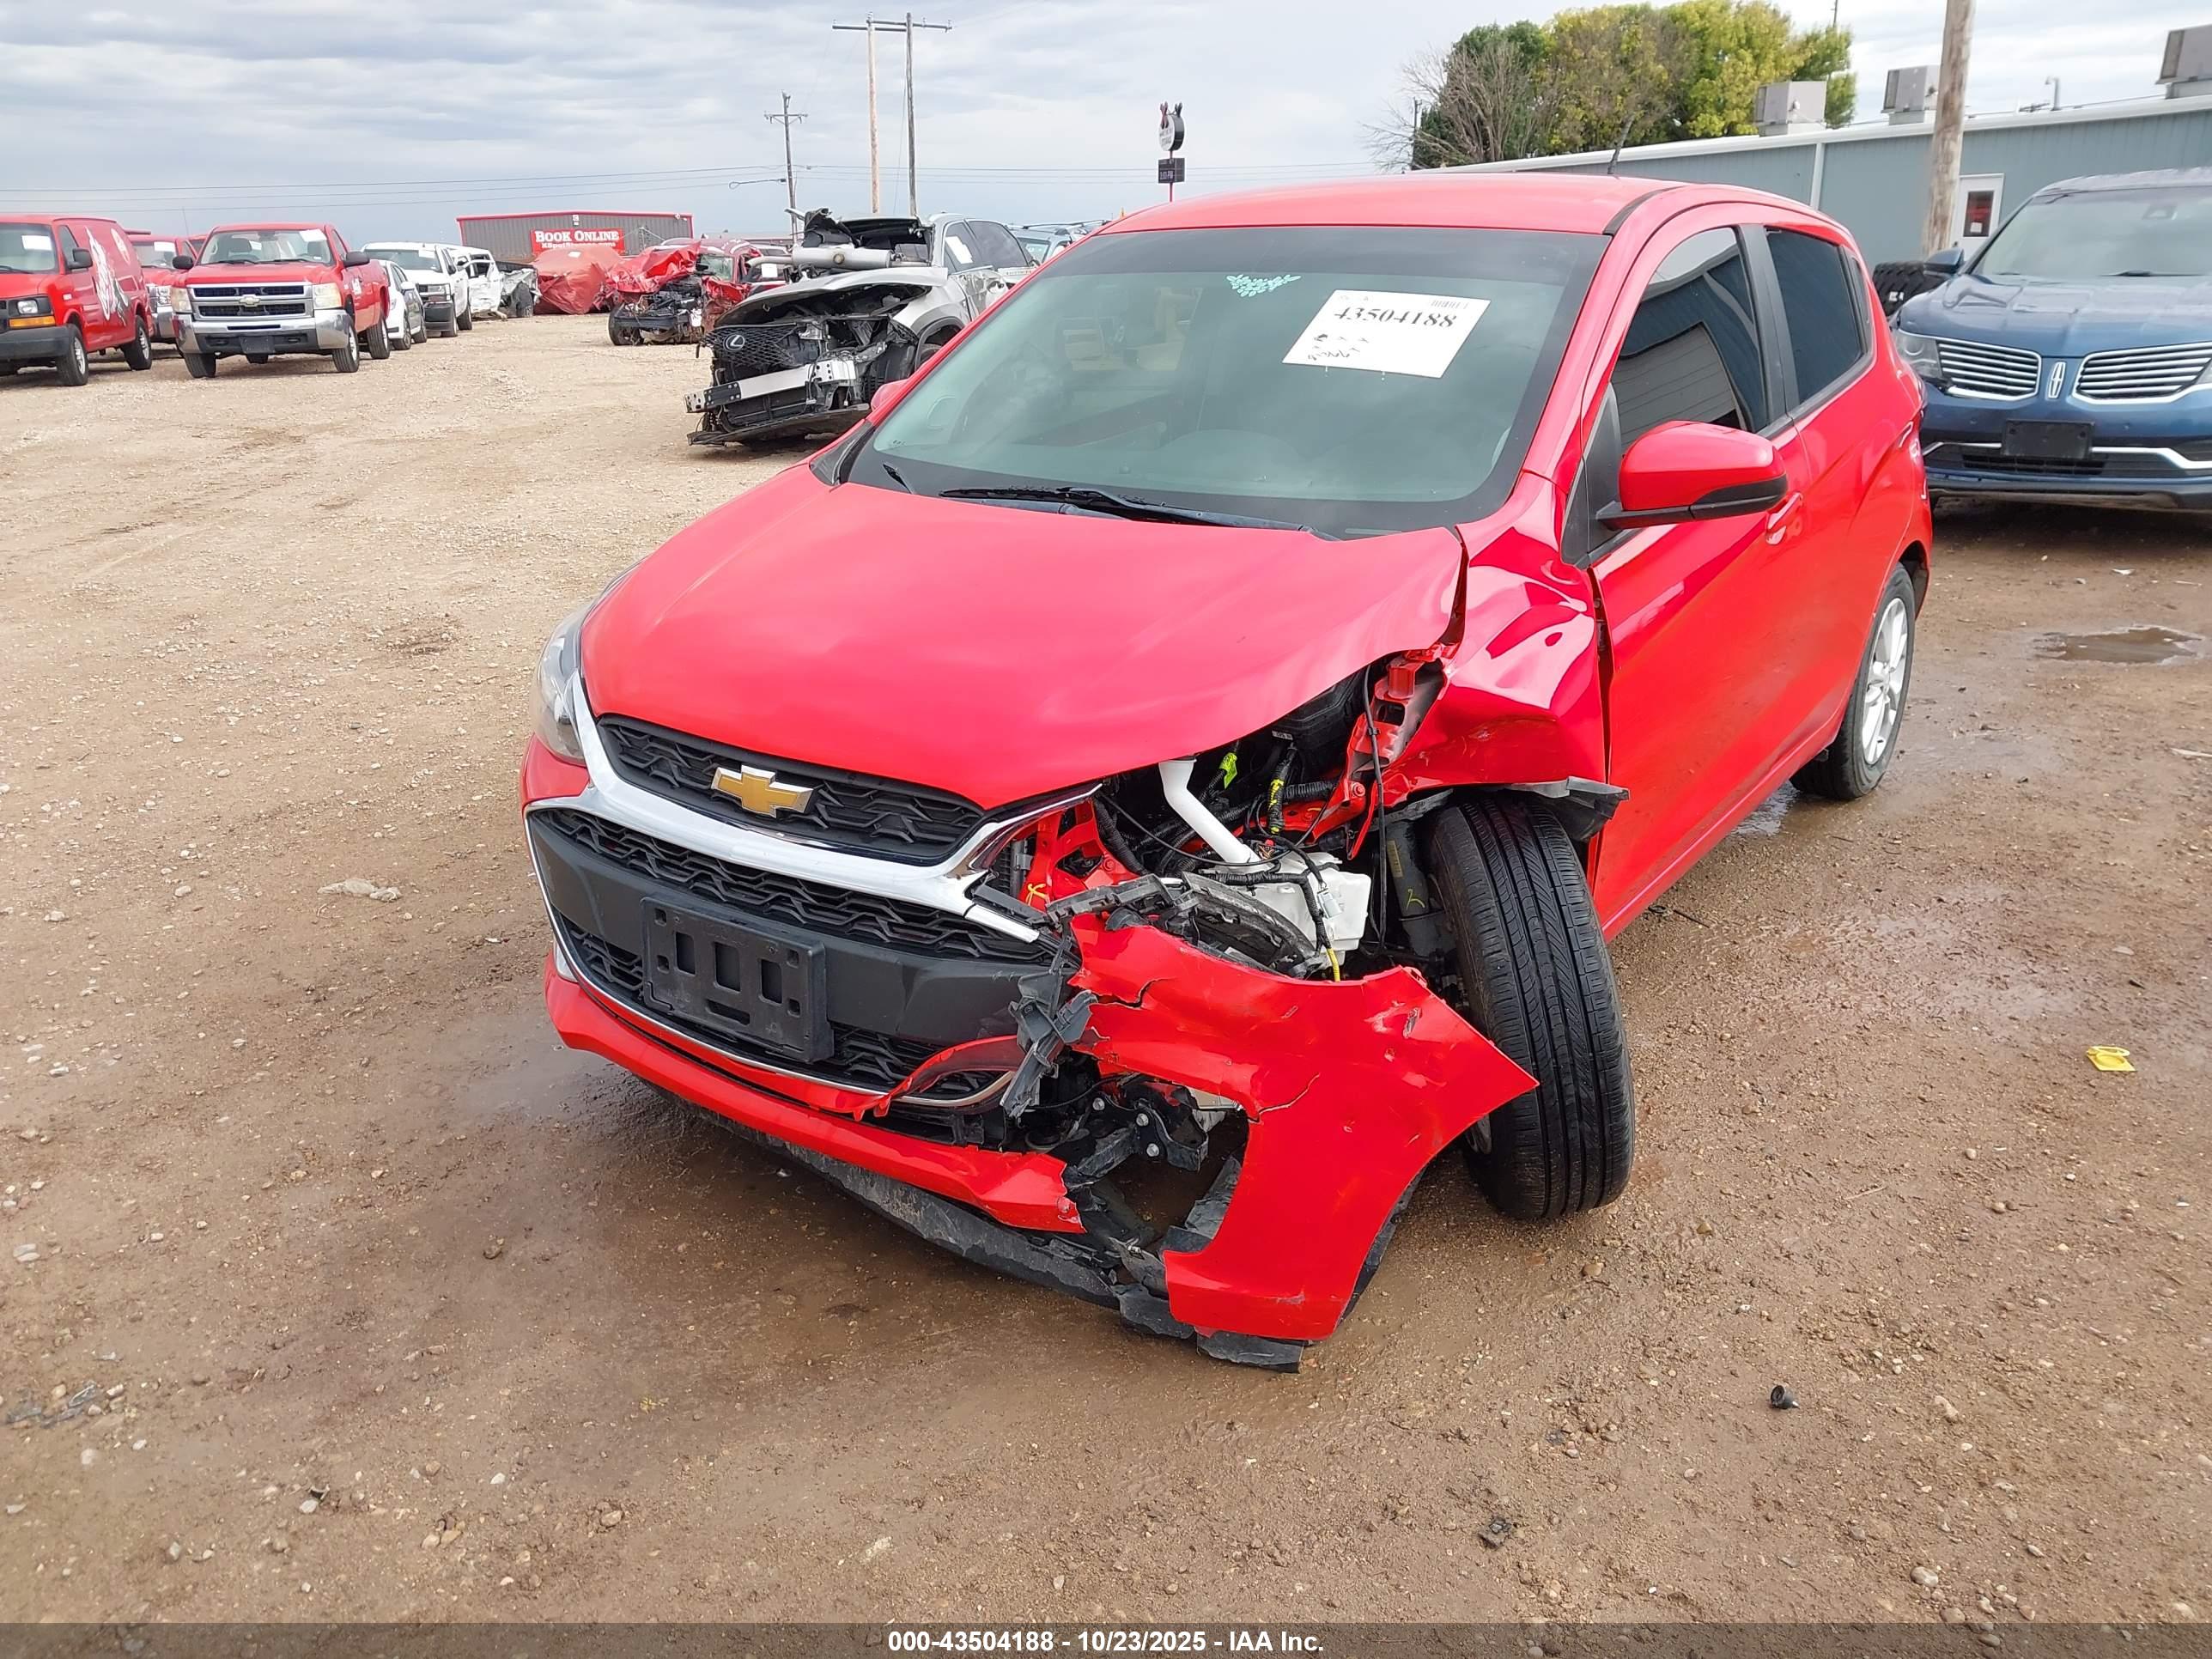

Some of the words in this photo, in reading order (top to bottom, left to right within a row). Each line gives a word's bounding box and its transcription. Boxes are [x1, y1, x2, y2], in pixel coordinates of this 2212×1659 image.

[535, 231, 572, 242] BOOK
[574, 230, 620, 241] ONLINE
[1334, 306, 1457, 328] 43504188
